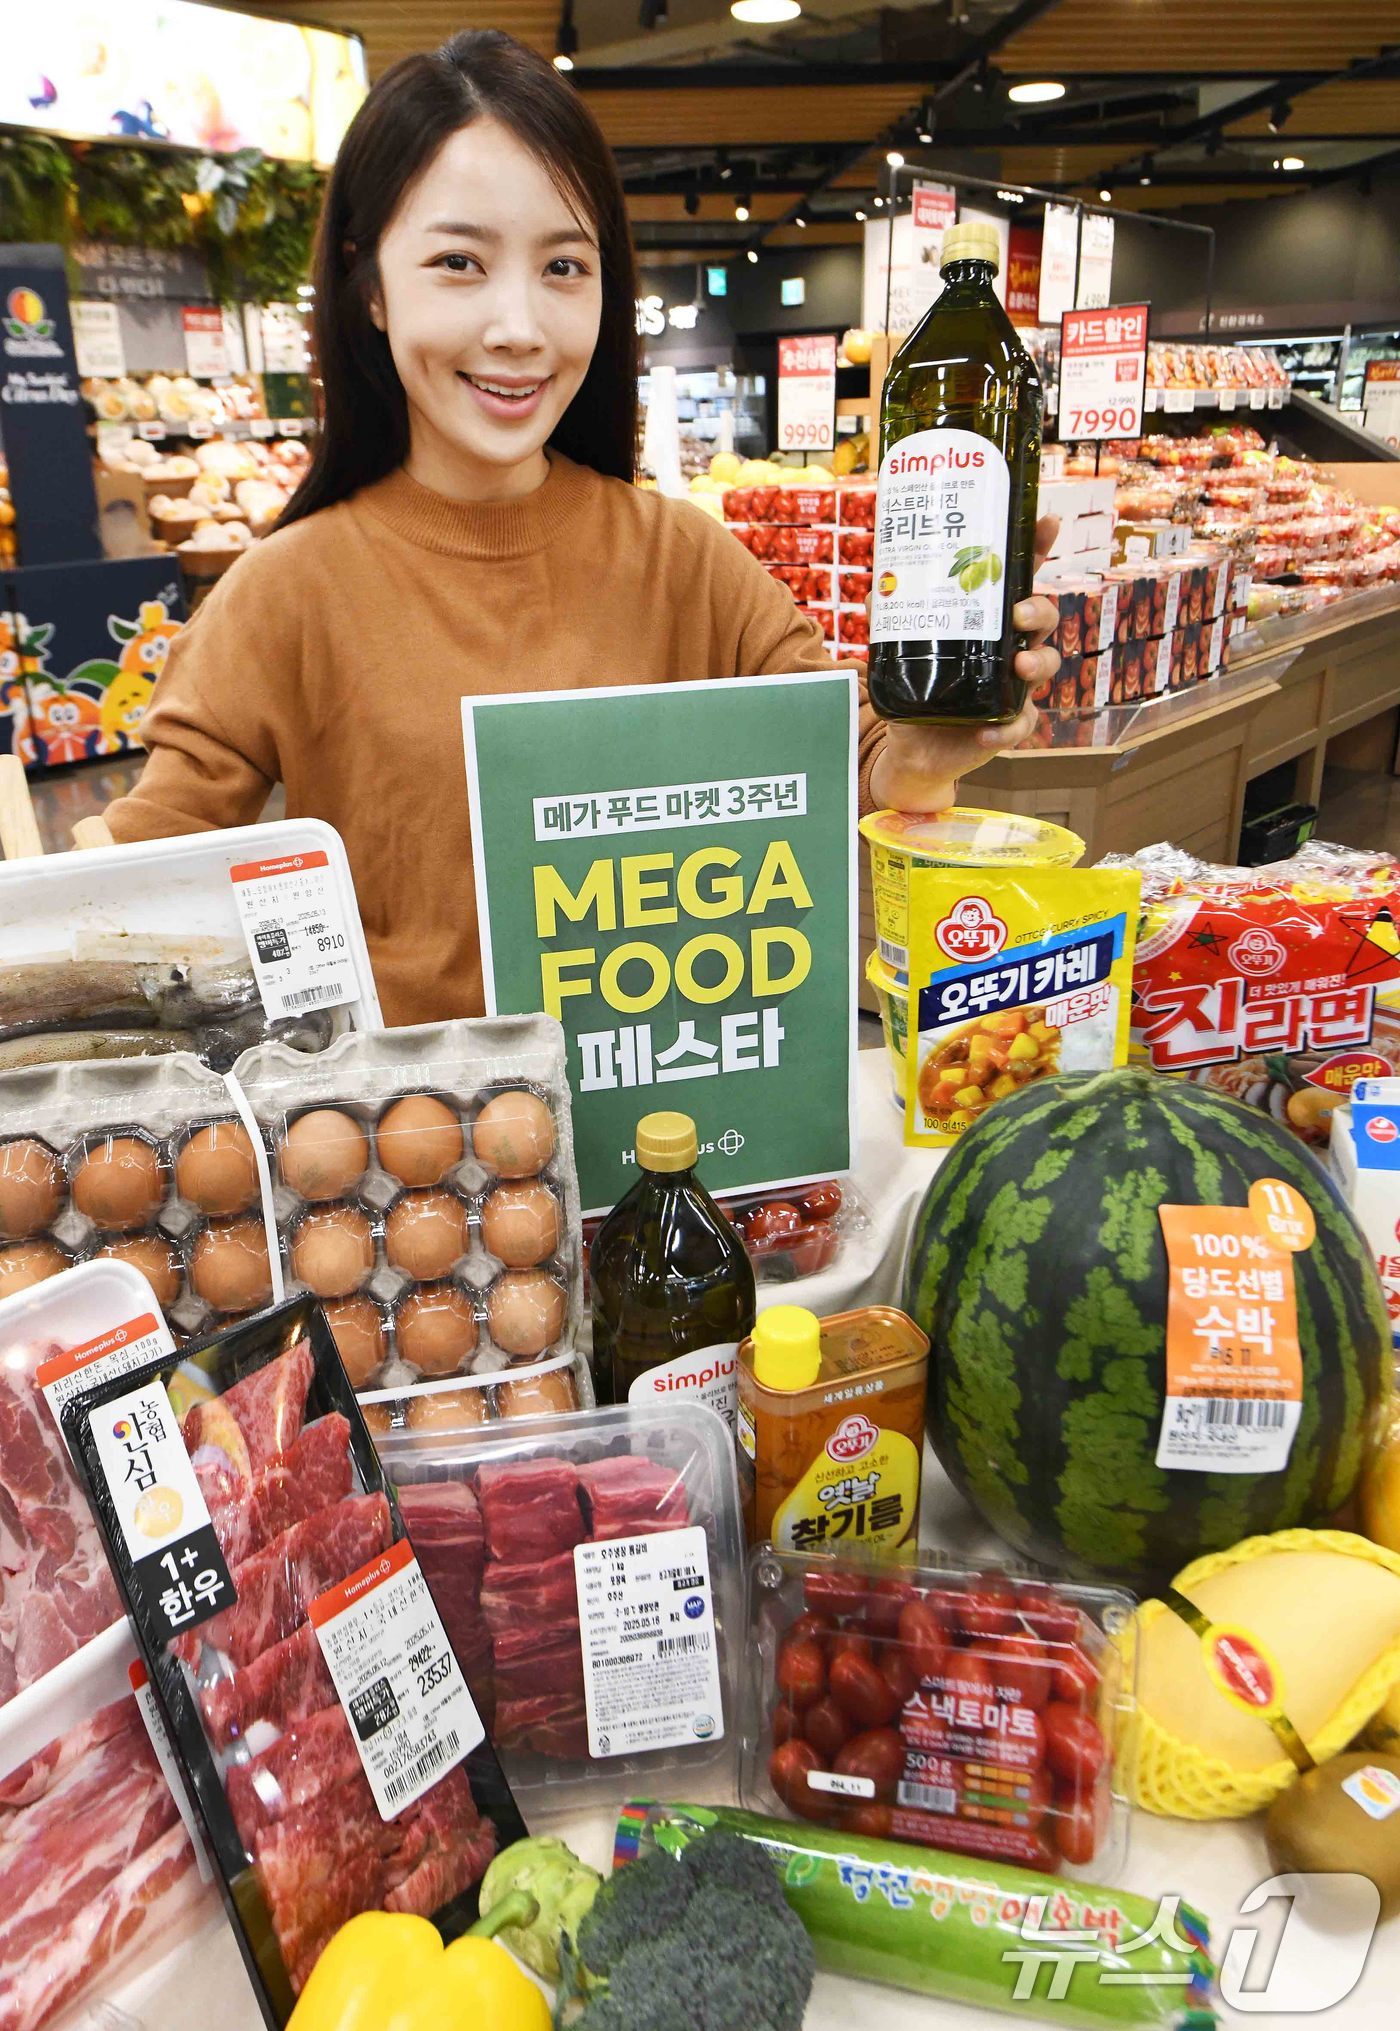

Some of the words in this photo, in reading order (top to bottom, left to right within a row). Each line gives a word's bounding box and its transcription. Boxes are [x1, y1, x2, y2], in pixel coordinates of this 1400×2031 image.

[1067, 315, 1142, 345] 카드할인
[890, 447, 985, 475] simplus
[880, 512, 966, 544] 올리브유
[544, 800, 600, 833] 메가
[606, 794, 660, 824] 푸드
[666, 787, 720, 820] 마켓
[727, 778, 799, 815] 3주년
[532, 840, 814, 939] MEGA
[1082, 909, 1108, 926] SPICY
[317, 934, 345, 952] 8910
[948, 930, 996, 948] 오뚜기
[540, 926, 812, 1022] FOOD
[1241, 954, 1272, 966] 오뚜기
[938, 964, 1029, 1022] 오뚜기
[1033, 944, 1098, 994] 카레
[1250, 986, 1261, 997] 더
[1264, 981, 1301, 996] 맛있게
[1045, 982, 1112, 1028] 매운맛
[1143, 977, 1376, 1072] 진라면
[576, 1007, 785, 1093] 페스타
[1262, 1184, 1294, 1216] 11
[1191, 1233, 1270, 1259] 100%
[1182, 1268, 1283, 1301] 당도선별
[1193, 1306, 1275, 1355] 수박
[74, 1337, 115, 1361] Homeplus
[140, 1400, 167, 1441] 농협
[113, 1412, 158, 1491] 안심
[836, 1435, 872, 1455] 오뚜기
[818, 1471, 881, 1511] 옛날
[791, 1494, 904, 1550] 참기름
[160, 1547, 199, 1582] 1+
[159, 1568, 225, 1628] 한우
[344, 1569, 381, 1598] Homeplus
[685, 1599, 703, 1610] MAP
[417, 1652, 452, 1697] 23537
[902, 1691, 1038, 1738] 스낵토마토
